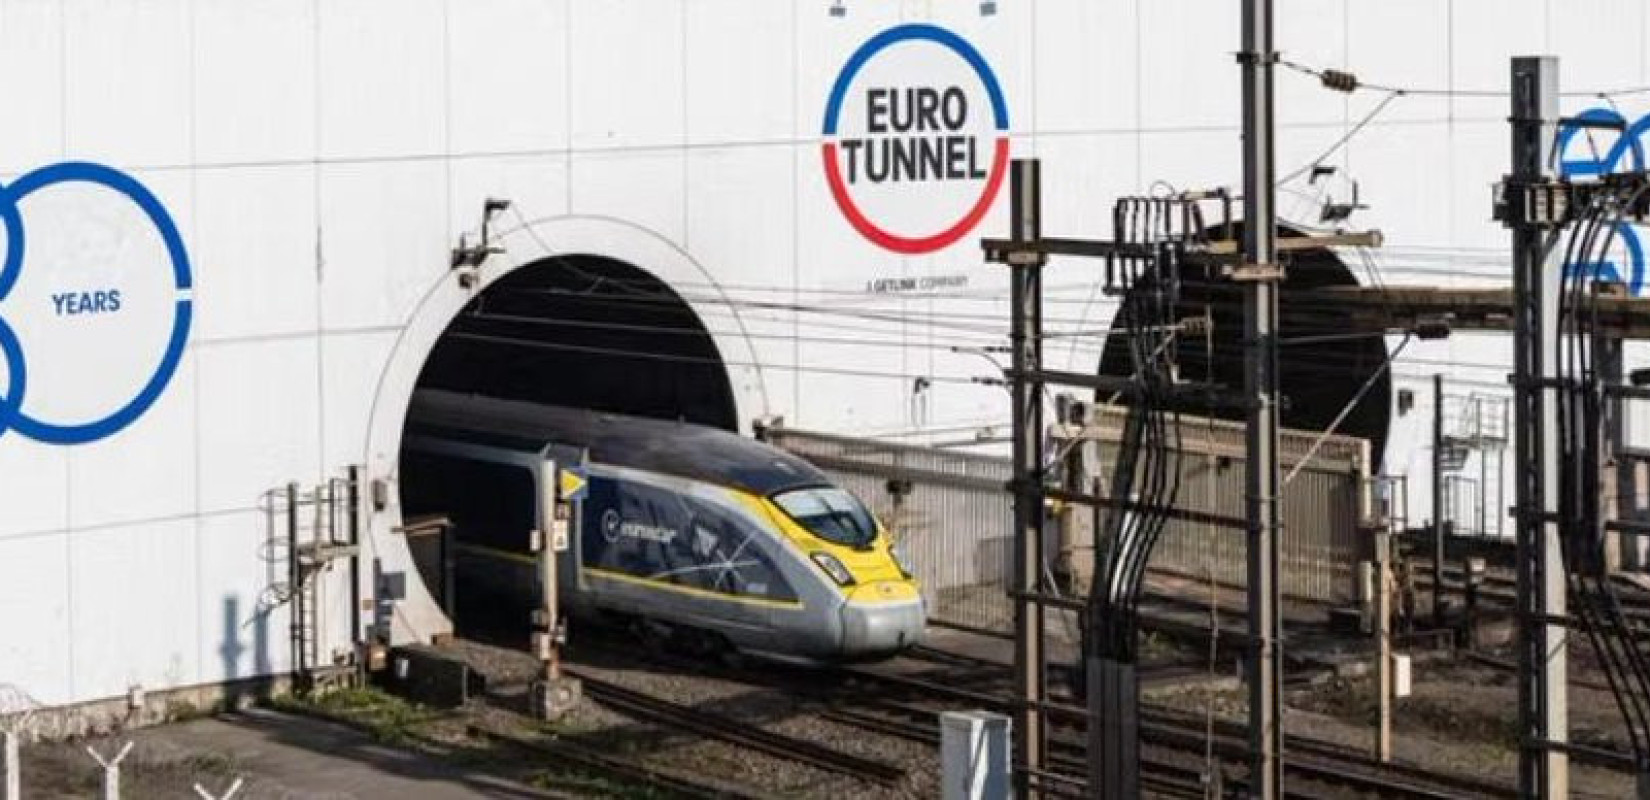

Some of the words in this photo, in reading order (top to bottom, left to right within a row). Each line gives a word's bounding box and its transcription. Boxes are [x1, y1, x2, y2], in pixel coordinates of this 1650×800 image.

[867, 86, 968, 133] EURO
[841, 136, 988, 184] TUNNEL
[52, 289, 121, 316] YEARS
